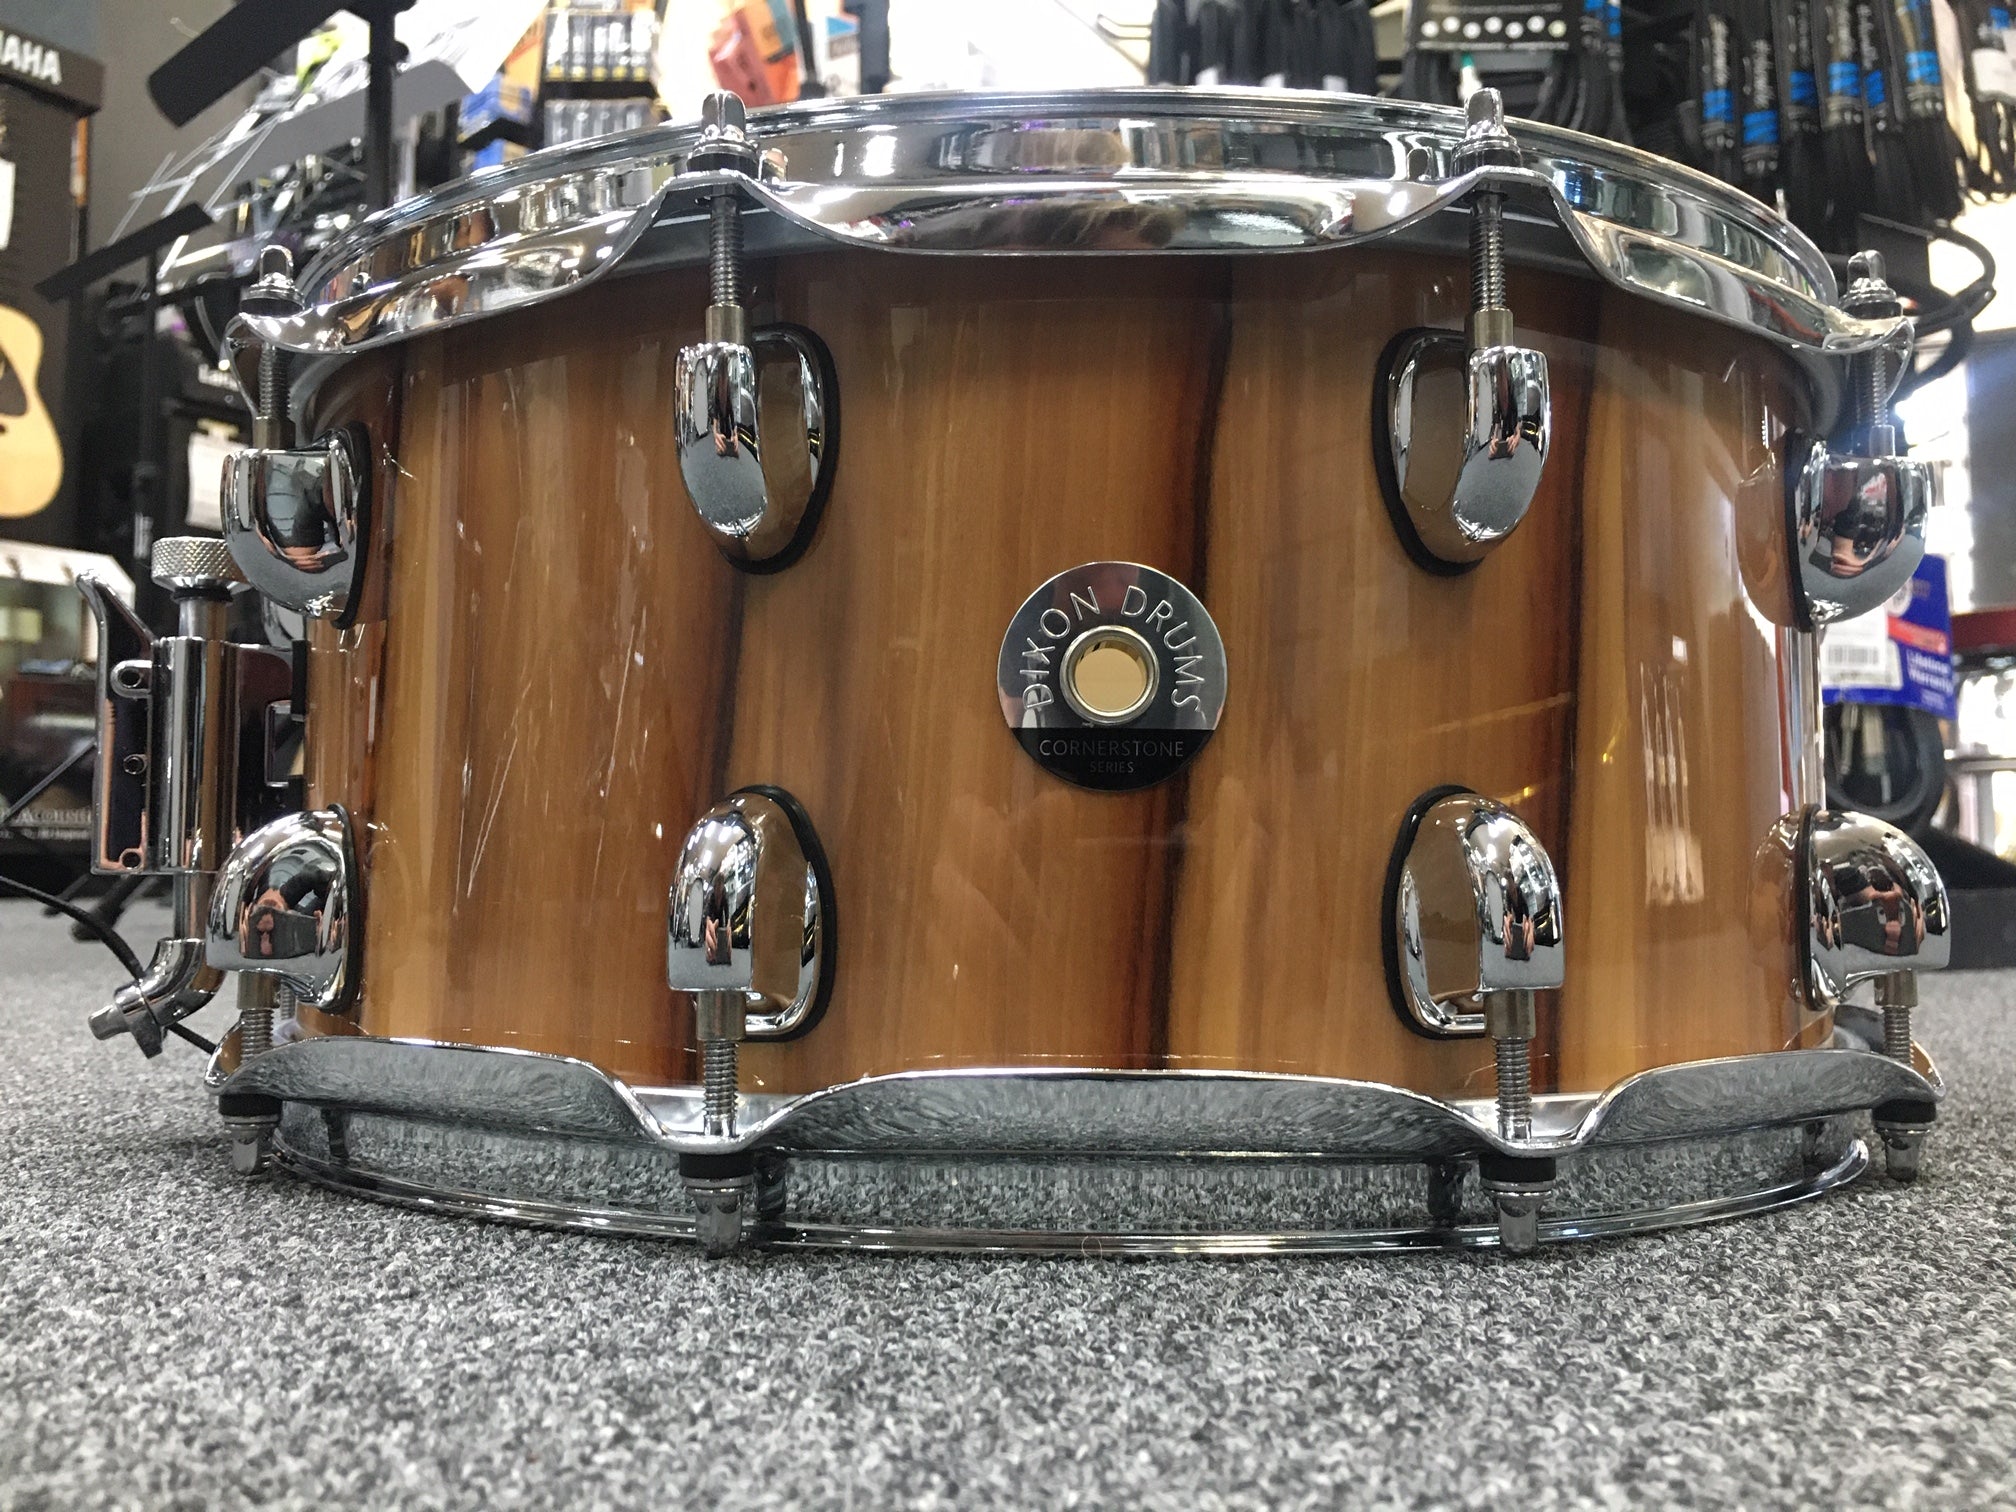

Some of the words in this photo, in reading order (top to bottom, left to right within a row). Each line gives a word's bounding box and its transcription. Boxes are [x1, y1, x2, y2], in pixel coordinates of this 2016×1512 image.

[0, 29, 62, 86] AHA
[1019, 585, 1101, 710] DIXON
[1120, 585, 1206, 712] DRUMS
[1039, 739, 1184, 757] CORNERSTONE
[1090, 761, 1134, 774] SERIES
